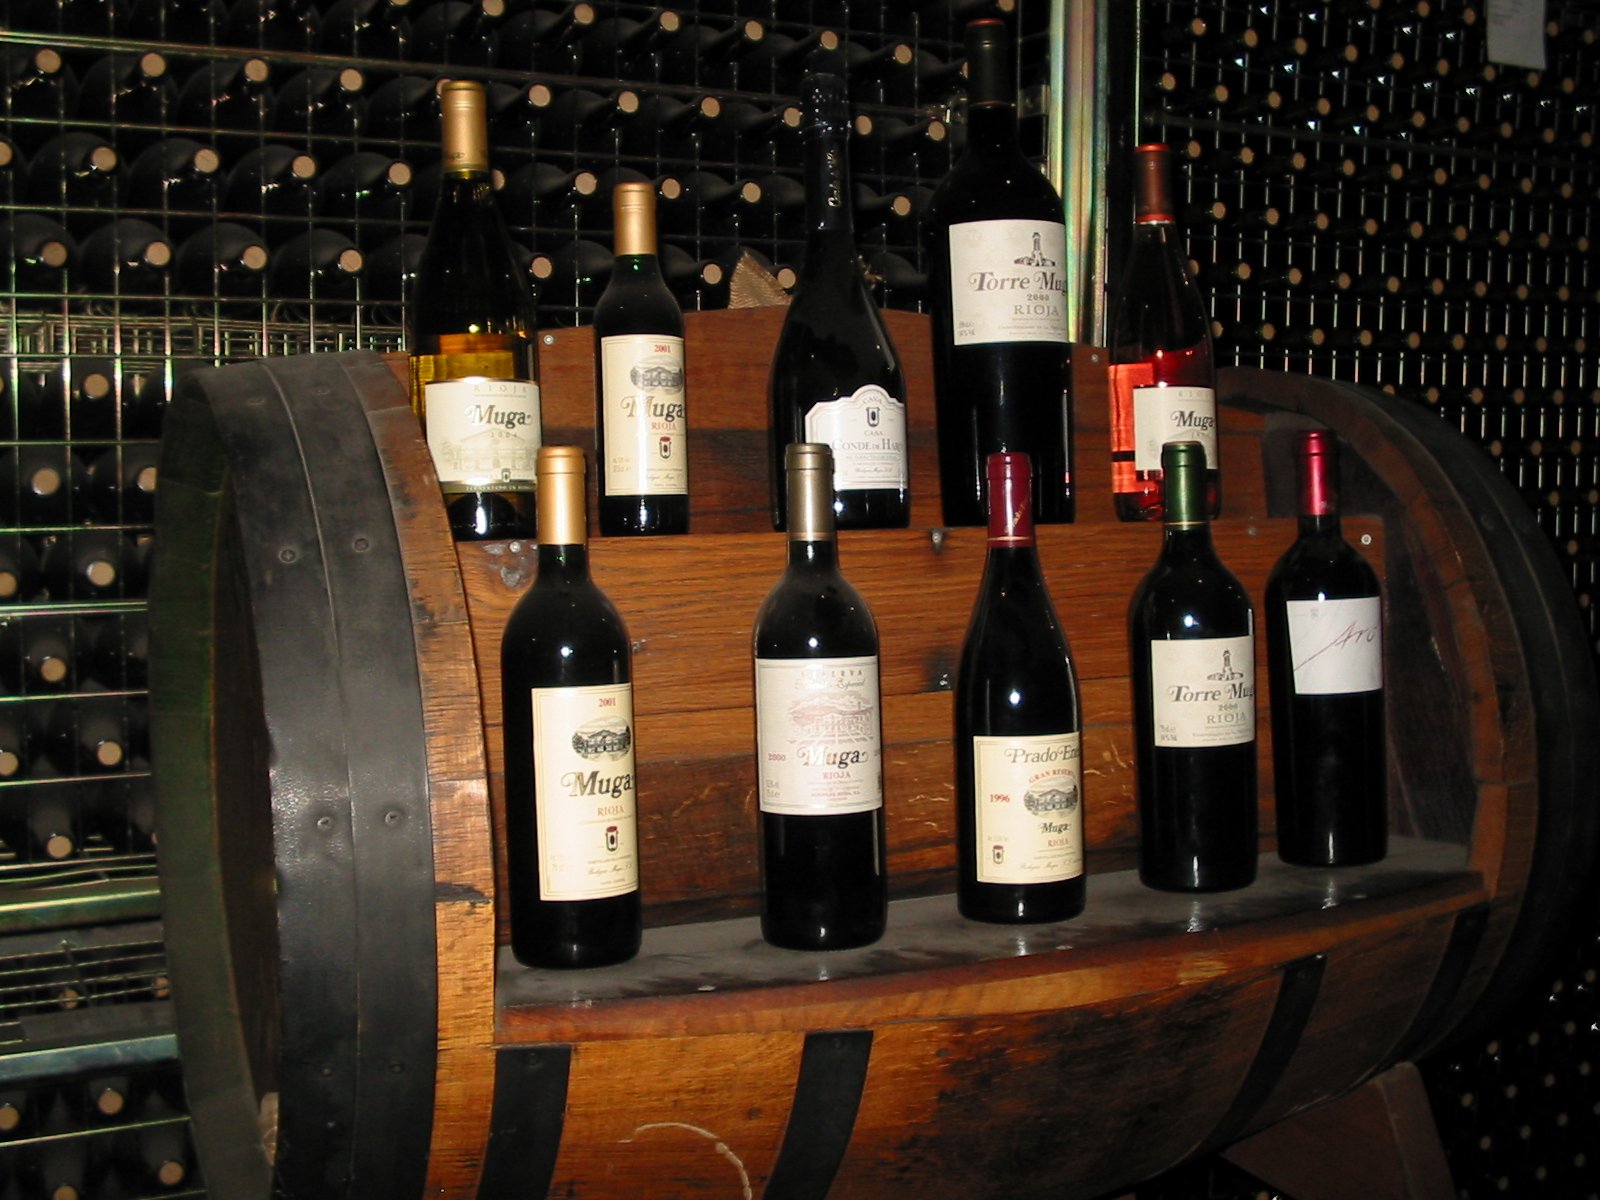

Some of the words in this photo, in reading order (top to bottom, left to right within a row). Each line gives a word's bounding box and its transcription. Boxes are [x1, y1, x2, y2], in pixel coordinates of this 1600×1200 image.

[968, 271, 1030, 292] Torre
[1014, 304, 1060, 316] RIOJA
[654, 344, 671, 353] 2001
[620, 395, 686, 423] Muga
[464, 404, 532, 429] Muga
[652, 422, 677, 430] RIOJA
[1167, 684, 1222, 702] Torre
[598, 698, 616, 707] 2001
[1207, 712, 1247, 724] RIOJA
[797, 746, 869, 769] Muga
[1004, 747, 1059, 763] Prado
[823, 772, 852, 780] RIOJA
[1028, 771, 1050, 783] GRAN
[561, 769, 634, 799] Muga
[989, 793, 1010, 803] 1996
[597, 805, 624, 816] RIOJA
[1040, 822, 1071, 834] Muga
